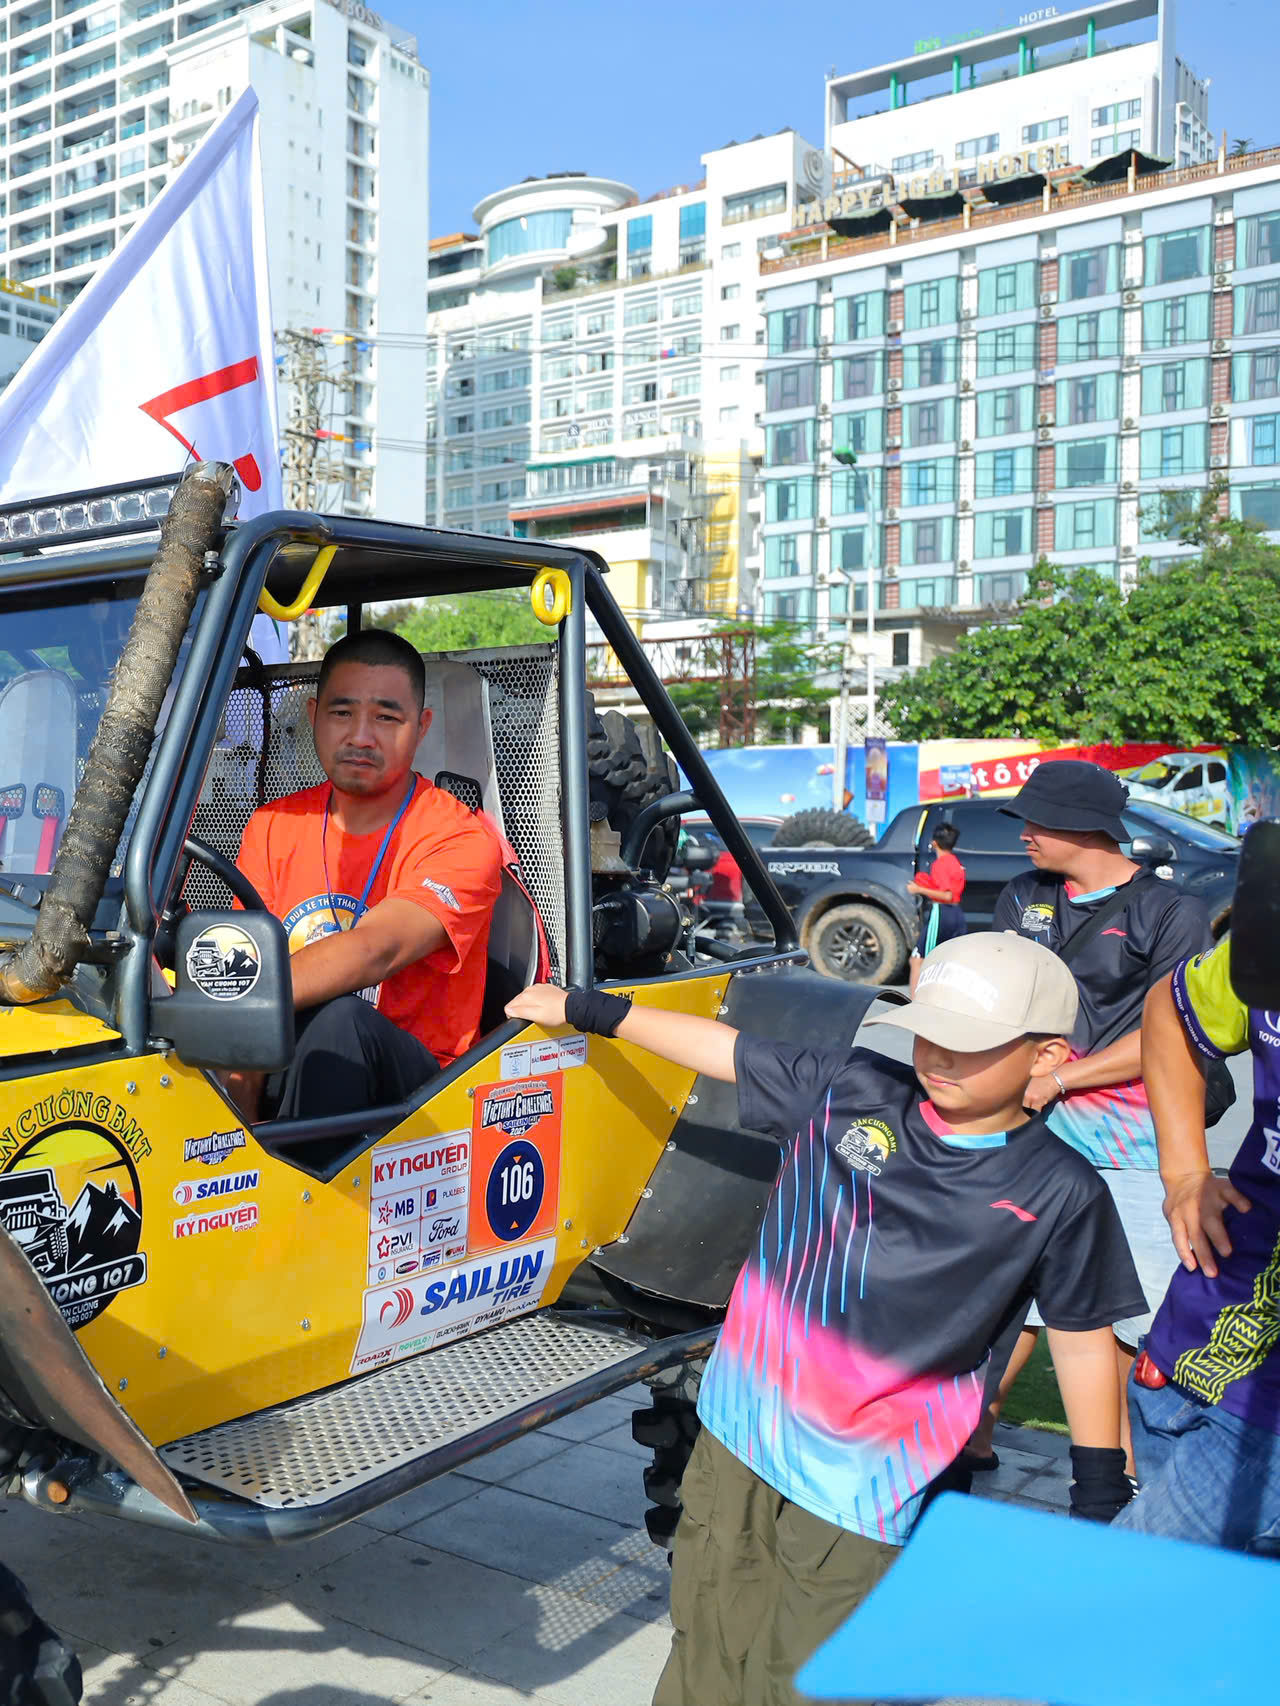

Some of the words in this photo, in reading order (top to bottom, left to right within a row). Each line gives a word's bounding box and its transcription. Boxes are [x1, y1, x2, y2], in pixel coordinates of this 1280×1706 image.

[1019, 6, 1059, 25] HOTEL
[791, 188, 872, 227] HAPPY
[882, 167, 961, 205] LIGHT
[978, 143, 1069, 184] HOTEL
[993, 763, 1012, 785] ô
[767, 862, 841, 876] RAPTOR
[305, 901, 318, 912] XE
[337, 897, 357, 910] THAO
[1174, 986, 1185, 1012] GROUP
[482, 1100, 516, 1127] VICTORY
[515, 1093, 554, 1120] CHALLENGE
[108, 1104, 153, 1163] BMT
[440, 1162, 468, 1176] GROUP
[196, 1172, 258, 1199] SAILUN
[501, 1161, 534, 1206] 106
[394, 1198, 415, 1219] MB
[428, 1217, 460, 1243] Ford
[390, 1243, 414, 1256] INSURANCE
[391, 1232, 412, 1249] PVI
[103, 1263, 134, 1290] 107
[421, 1250, 544, 1315] SAILUN
[492, 1280, 535, 1307] TIRE
[80, 1310, 94, 1321] 007
[474, 1306, 506, 1325] DYNAMO
[436, 1320, 470, 1339] BLACKHAWK
[456, 1328, 468, 1337] TIRE
[357, 1348, 392, 1366] ROADX
[374, 1357, 389, 1367] TIRE
